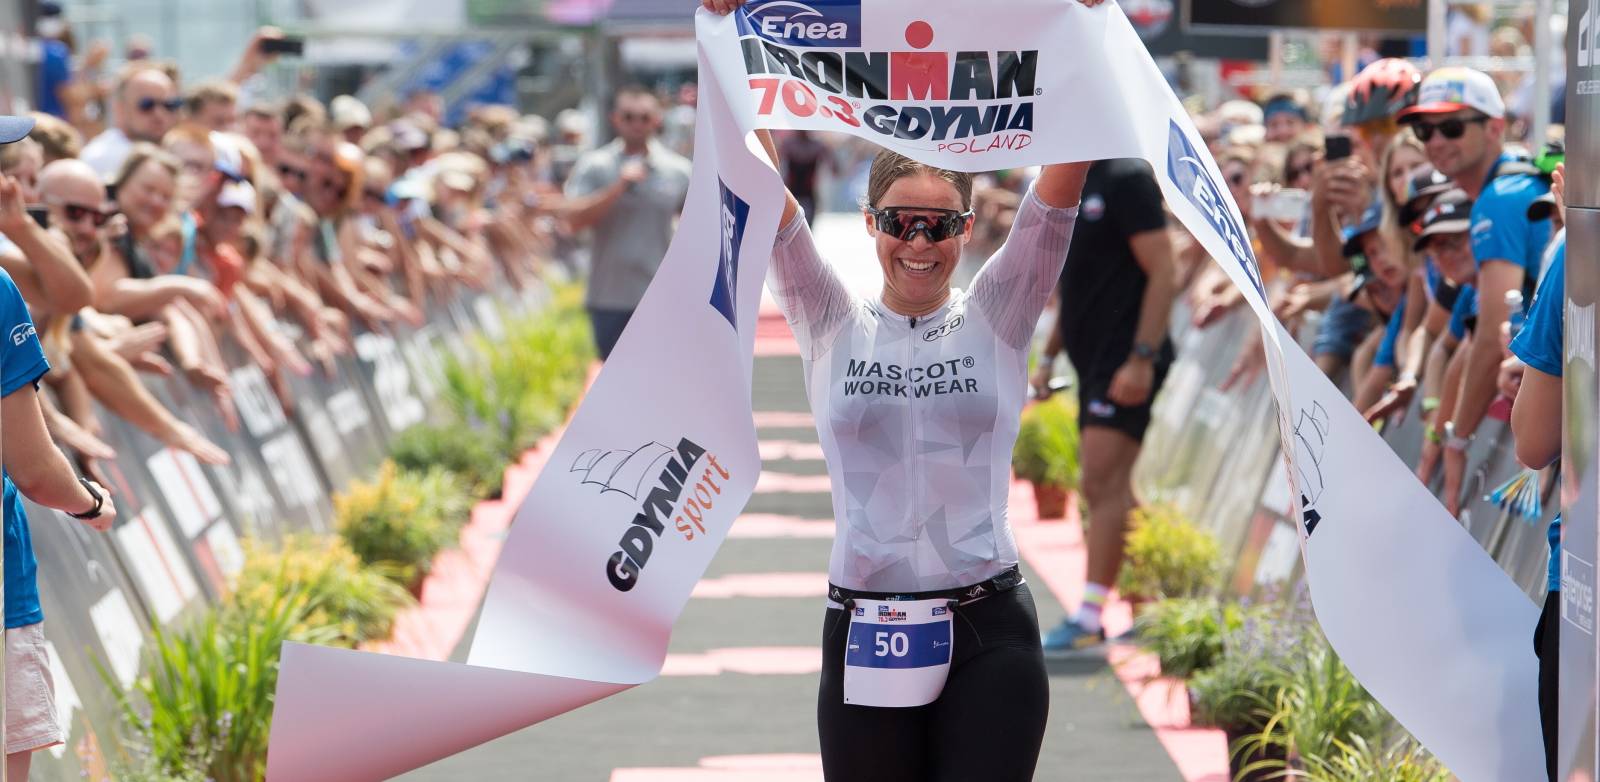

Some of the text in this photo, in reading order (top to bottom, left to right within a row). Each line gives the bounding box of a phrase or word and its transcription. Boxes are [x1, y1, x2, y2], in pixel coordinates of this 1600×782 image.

[761, 16, 848, 39] Enea
[863, 102, 1033, 141] GDYNIA
[938, 134, 1032, 153] POLAND
[1192, 174, 1260, 287] Enea
[13, 326, 37, 346] Ene
[926, 317, 961, 339] PTO
[675, 452, 730, 541] sport
[606, 437, 707, 592] GDYNIA
[874, 631, 909, 657] 50
